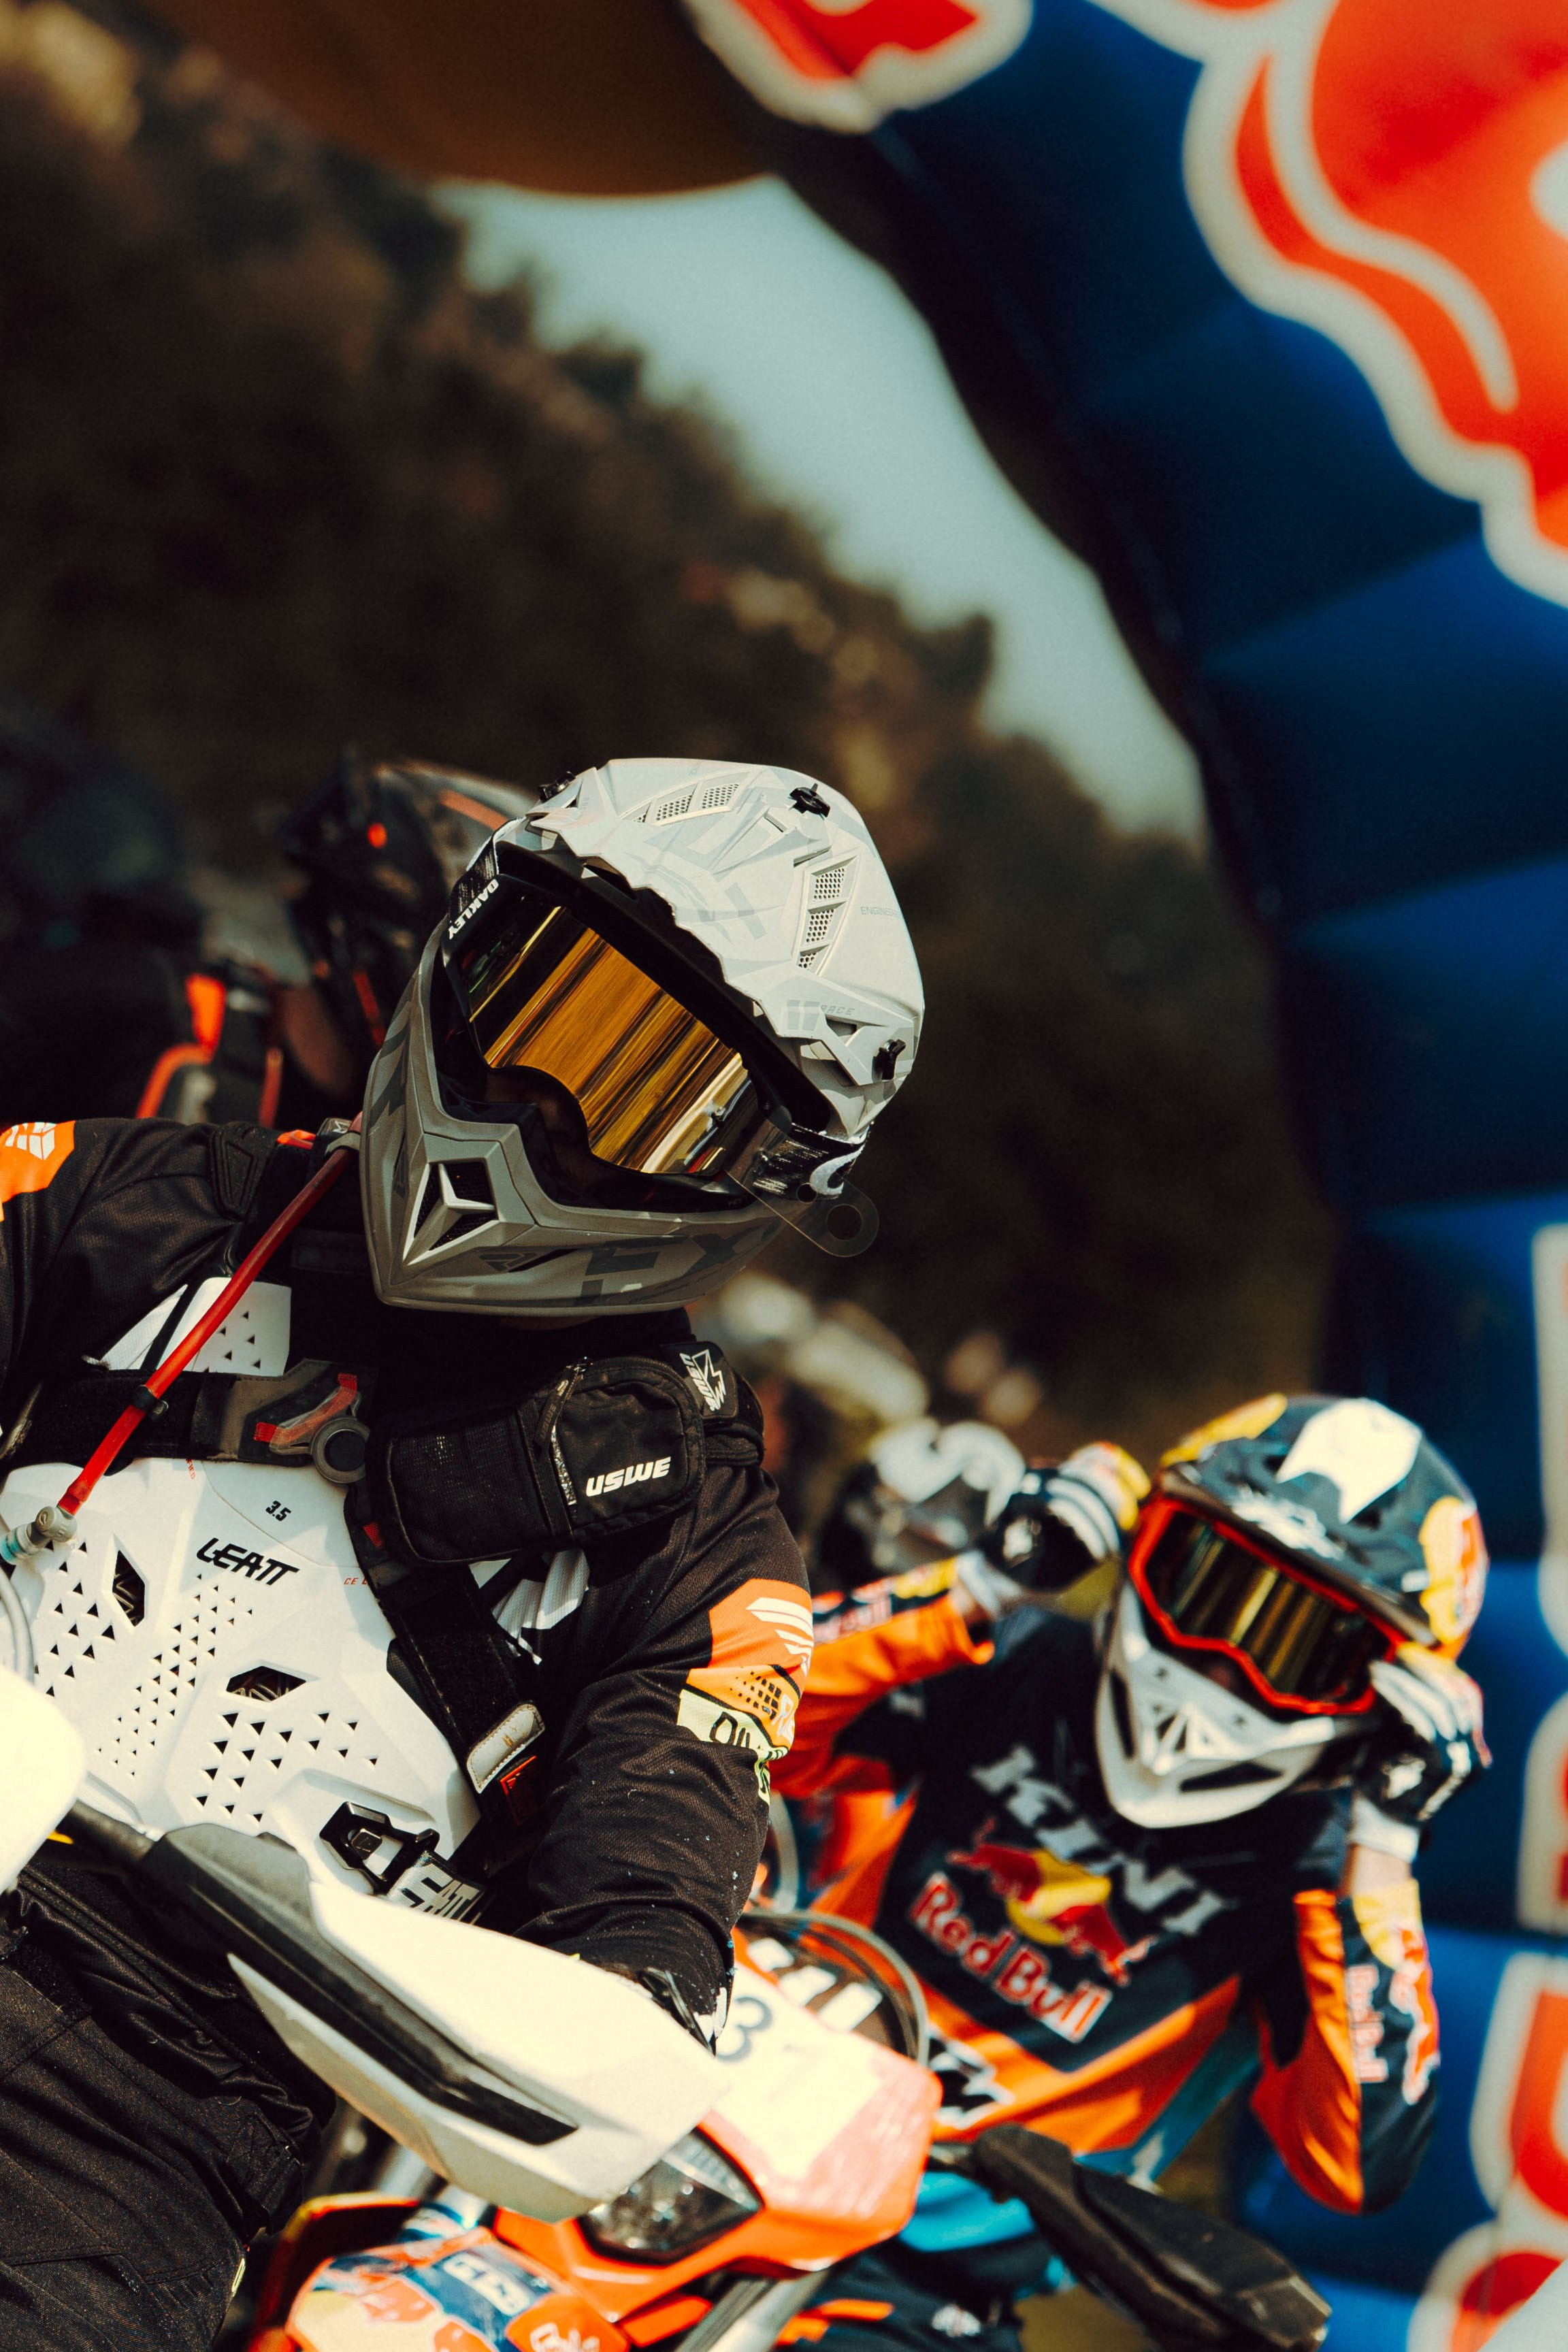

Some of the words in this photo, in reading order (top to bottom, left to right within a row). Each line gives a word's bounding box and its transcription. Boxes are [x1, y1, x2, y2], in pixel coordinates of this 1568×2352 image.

[448, 879, 500, 940] OAKLEY
[679, 1352, 721, 1411] USWE
[586, 1456, 671, 1497] USWE
[265, 1500, 291, 1522] 3.5
[196, 1537, 299, 1586] LEATT
[343, 1577, 359, 1586] CE
[911, 1870, 1015, 1978] Red
[994, 1946, 1113, 2043] Bull
